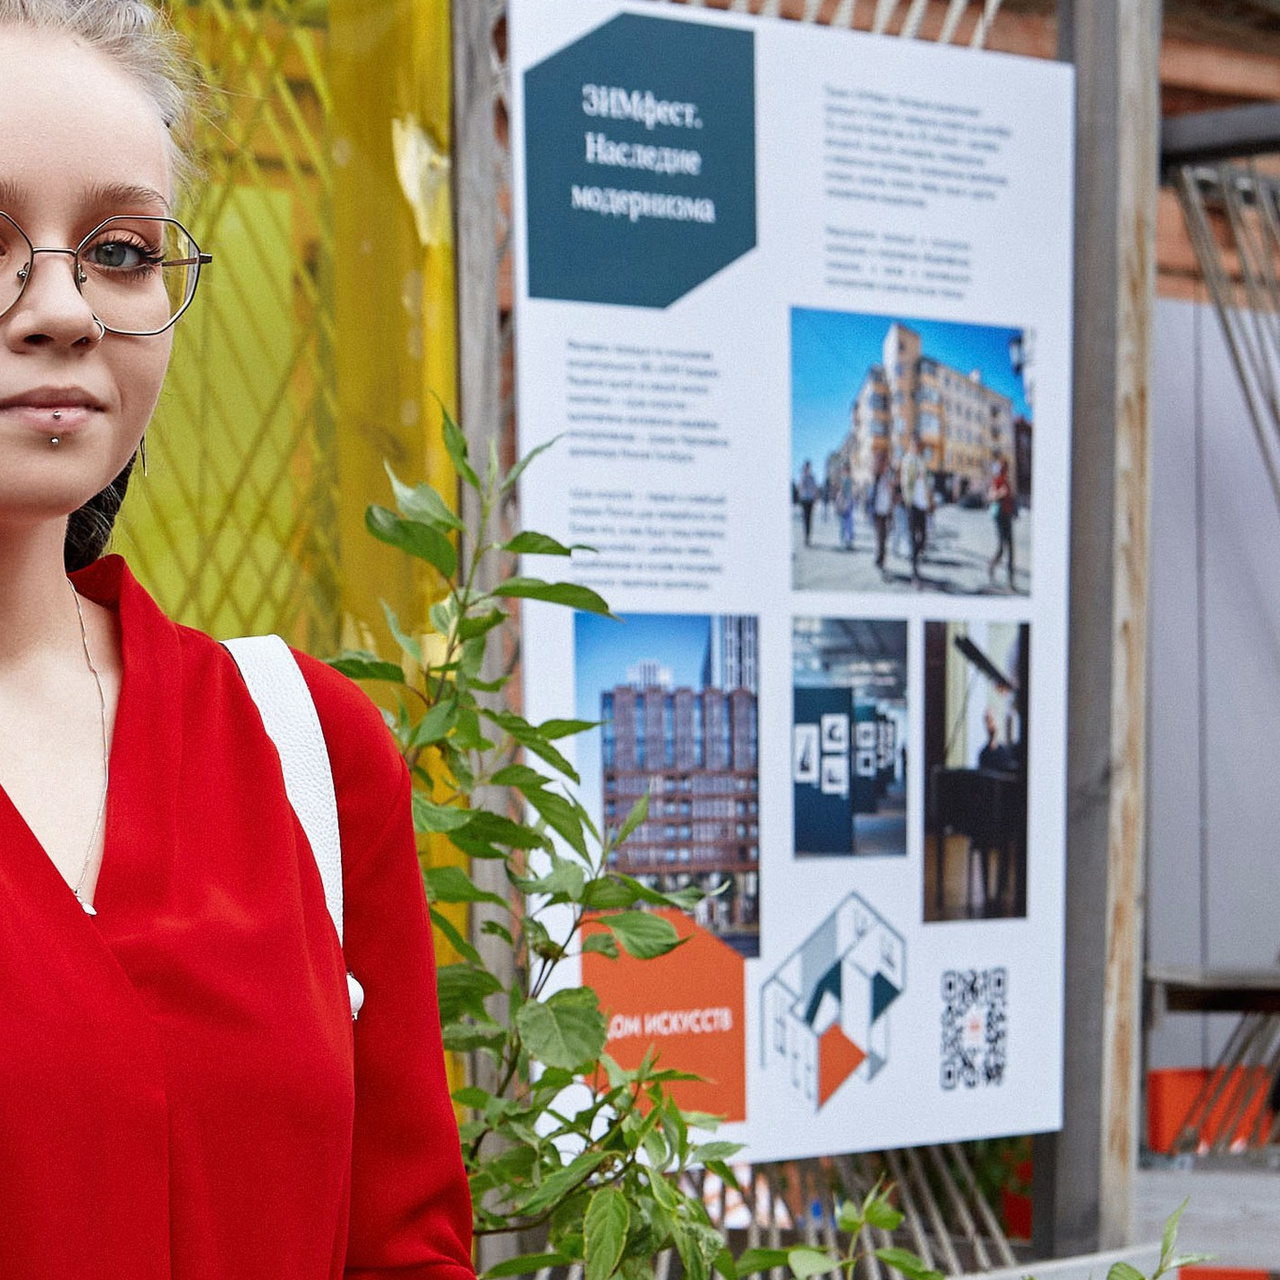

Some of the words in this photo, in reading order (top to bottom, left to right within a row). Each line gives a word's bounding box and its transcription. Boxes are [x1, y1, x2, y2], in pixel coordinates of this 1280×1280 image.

[582, 83, 703, 130] ЗИМфест.
[584, 131, 702, 176] Наследие
[571, 184, 716, 223] модернизма
[606, 1014, 642, 1040] ОМ
[644, 1007, 732, 1035] ИСКУССТВ
